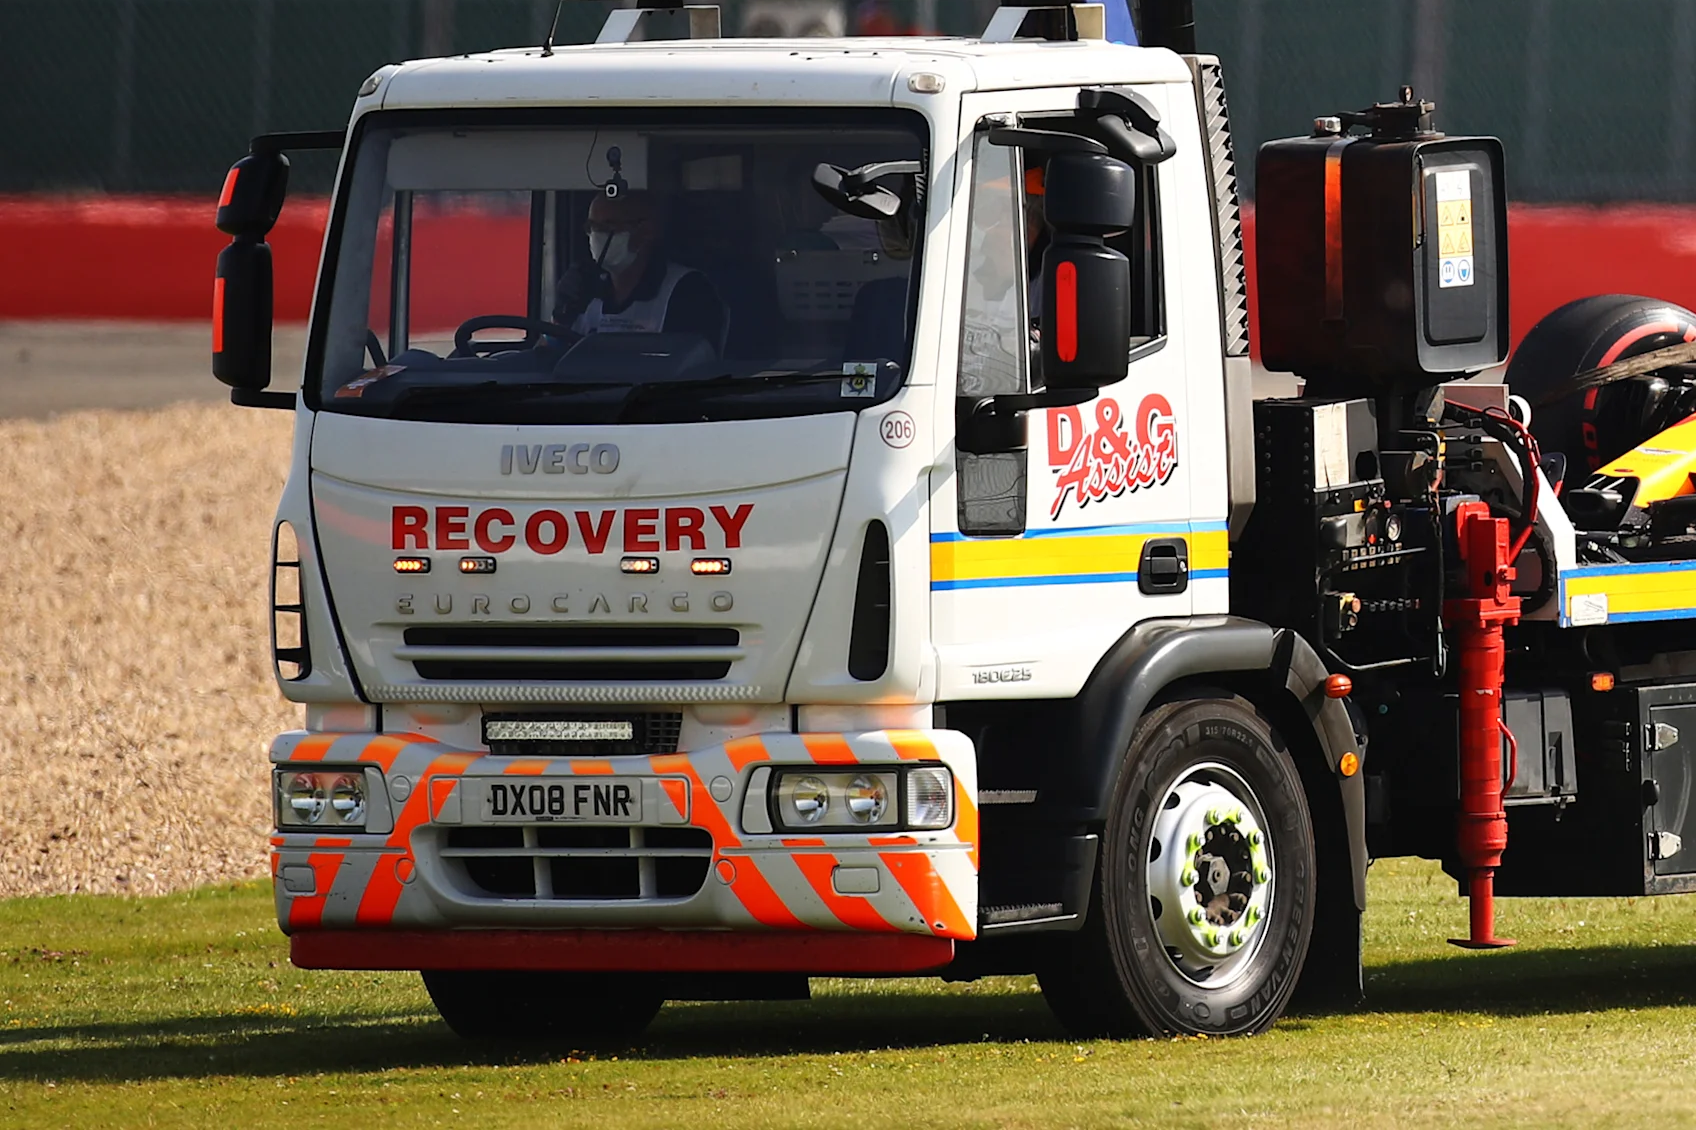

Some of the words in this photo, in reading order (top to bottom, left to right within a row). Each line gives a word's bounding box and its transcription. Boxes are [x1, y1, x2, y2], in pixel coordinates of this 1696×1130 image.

[885, 420, 912, 439] 206
[1046, 393, 1177, 468] D&G
[500, 443, 620, 476] IVECO
[1050, 431, 1176, 518] Assist
[391, 503, 755, 556] RECOVERY
[396, 590, 735, 615] EUROCARGO
[491, 784, 565, 816] DX08
[573, 784, 631, 817] FNR
